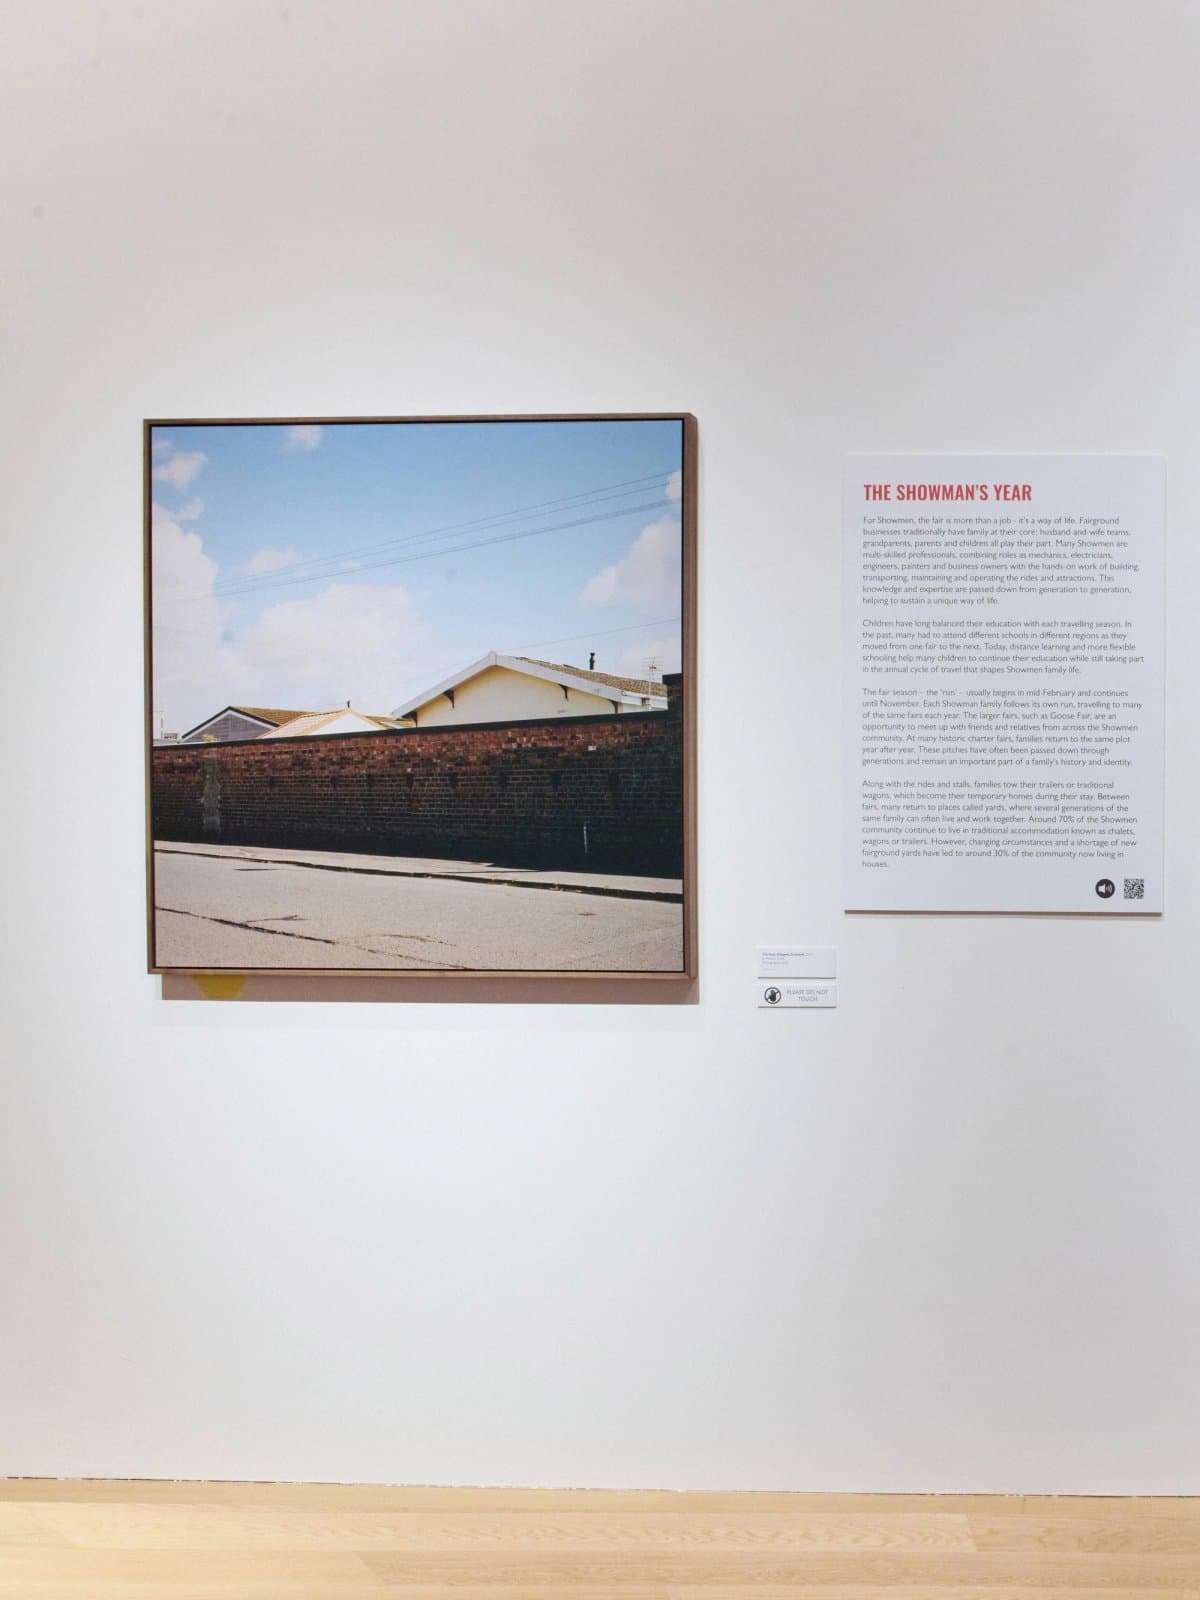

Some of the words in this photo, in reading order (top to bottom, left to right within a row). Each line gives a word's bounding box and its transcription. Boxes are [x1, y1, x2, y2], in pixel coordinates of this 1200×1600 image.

[864, 484, 891, 501] THE
[897, 484, 989, 501] SHOWMAN'S
[993, 484, 1032, 501] YEAR
[902, 528, 947, 537] traditionally
[966, 528, 989, 538] family
[914, 539, 942, 548] parents
[1000, 539, 1015, 549] play
[1055, 539, 1076, 549] Many
[959, 551, 997, 560] combining
[901, 562, 931, 571] painters
[911, 574, 953, 583] maintaining
[969, 575, 1005, 584] operating
[862, 596, 889, 606] helping
[933, 597, 959, 606] unique
[914, 619, 932, 629] long
[1060, 620, 1095, 629] travelling
[1041, 642, 1071, 652] learning
[979, 699, 1003, 709] family
[1077, 700, 1111, 710] travelling
[862, 723, 906, 732] opportunity
[967, 793, 1007, 802] temporary
[1034, 792, 1059, 802] during
[937, 803, 961, 812] places
[1061, 804, 1105, 813] generations
[862, 826, 903, 835] community
